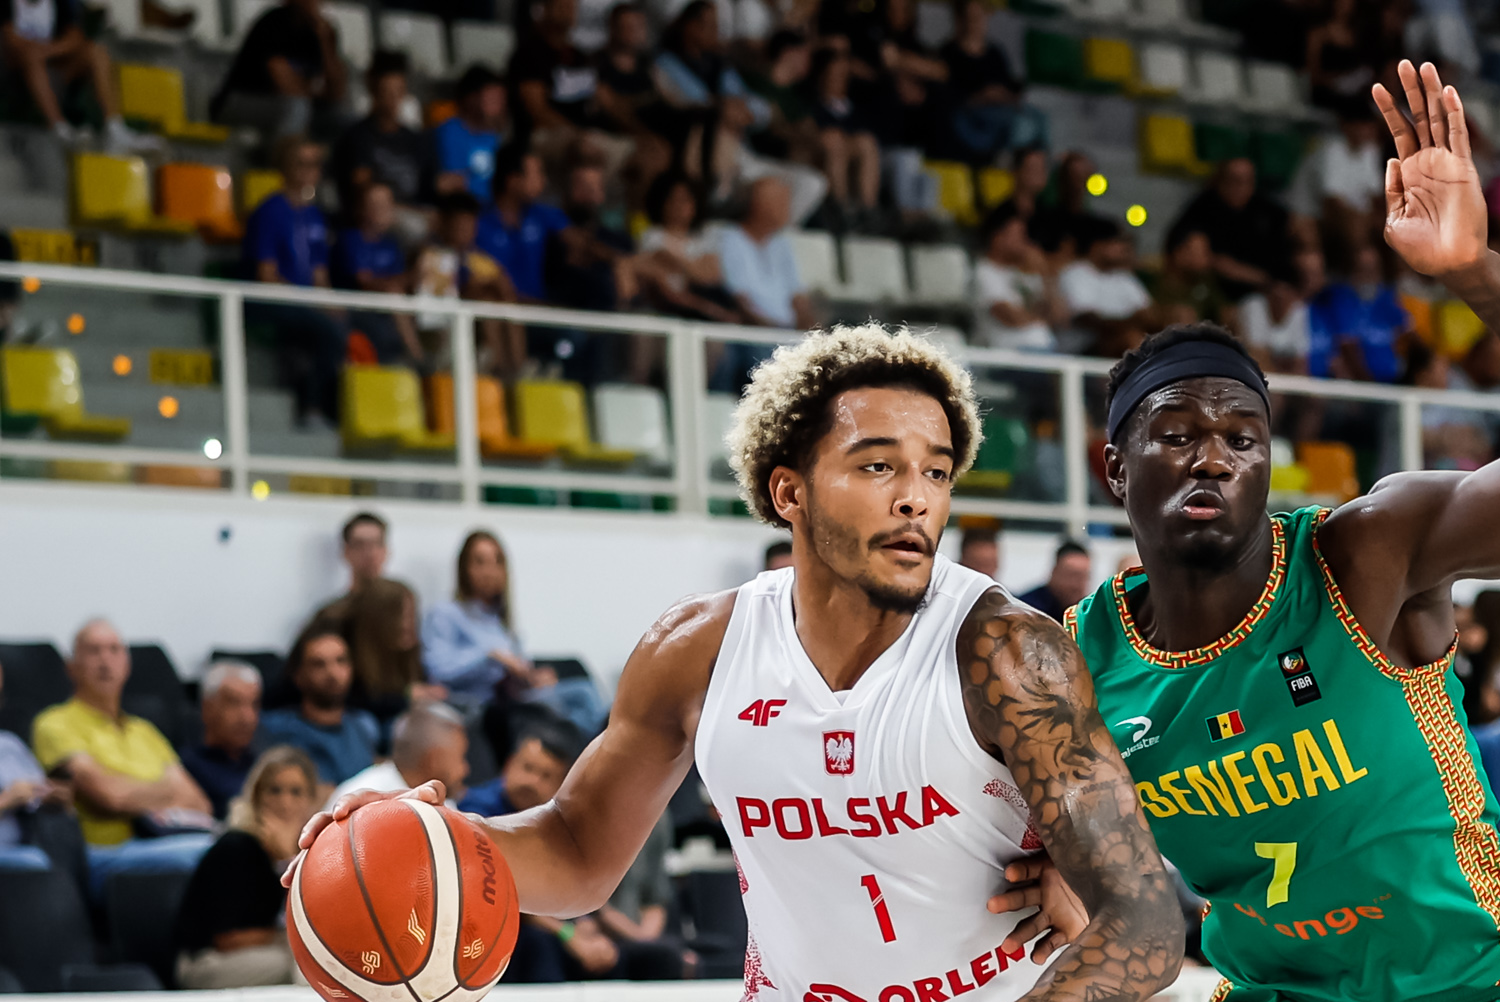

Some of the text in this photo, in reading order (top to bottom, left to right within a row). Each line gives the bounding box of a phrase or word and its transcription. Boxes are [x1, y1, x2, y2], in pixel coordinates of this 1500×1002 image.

[1291, 676, 1313, 691] FIBA
[738, 699, 787, 726] 4F
[1121, 735, 1160, 759] ajester
[1135, 718, 1368, 818] SENEGAL
[736, 785, 960, 840] POLSKA
[1254, 841, 1298, 908] 7
[860, 874, 897, 943] 1
